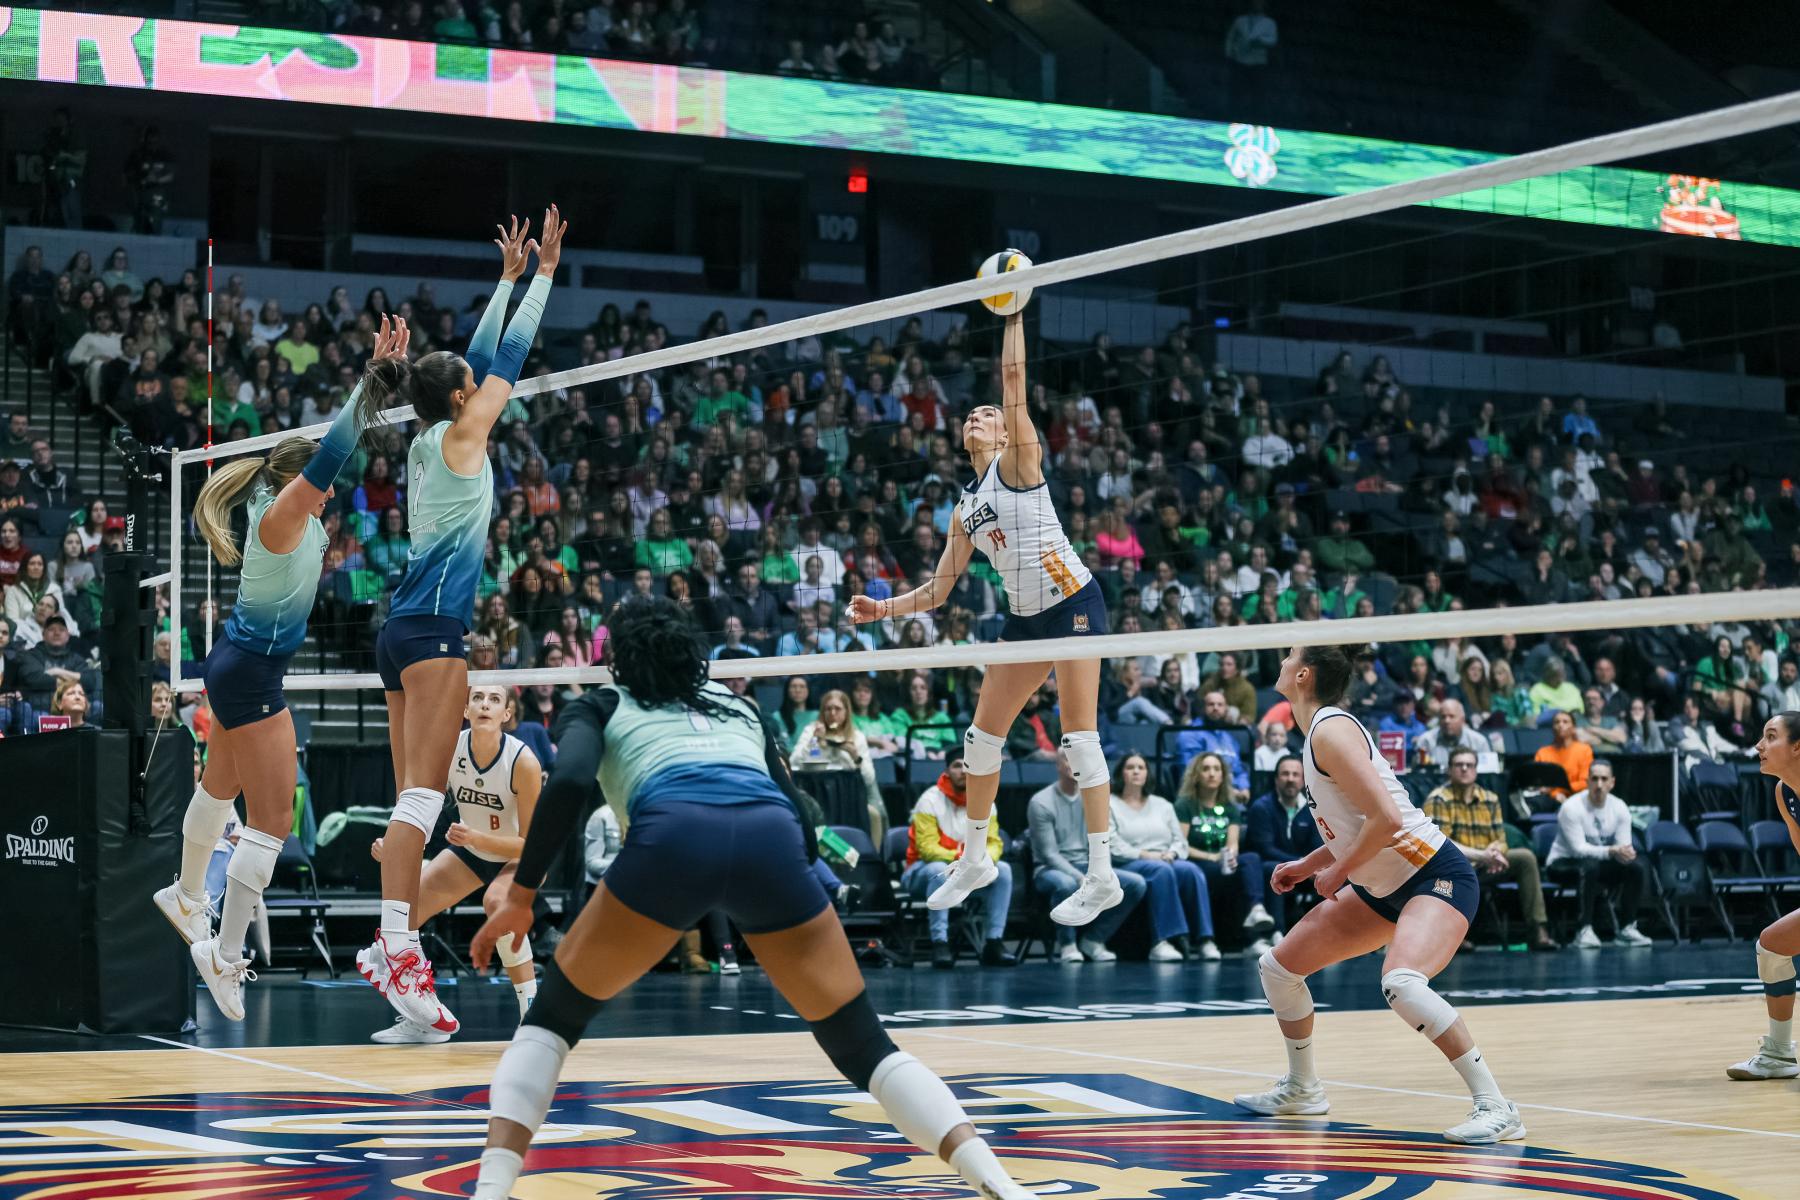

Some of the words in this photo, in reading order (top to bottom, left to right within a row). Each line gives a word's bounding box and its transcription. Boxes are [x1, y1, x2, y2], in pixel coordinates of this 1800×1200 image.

[817, 214, 859, 242] 109
[412, 460, 425, 516] 7
[963, 503, 996, 535] RISE
[987, 528, 1007, 551] 14
[458, 787, 501, 808] RISE
[5, 833, 76, 864] SPALDING
